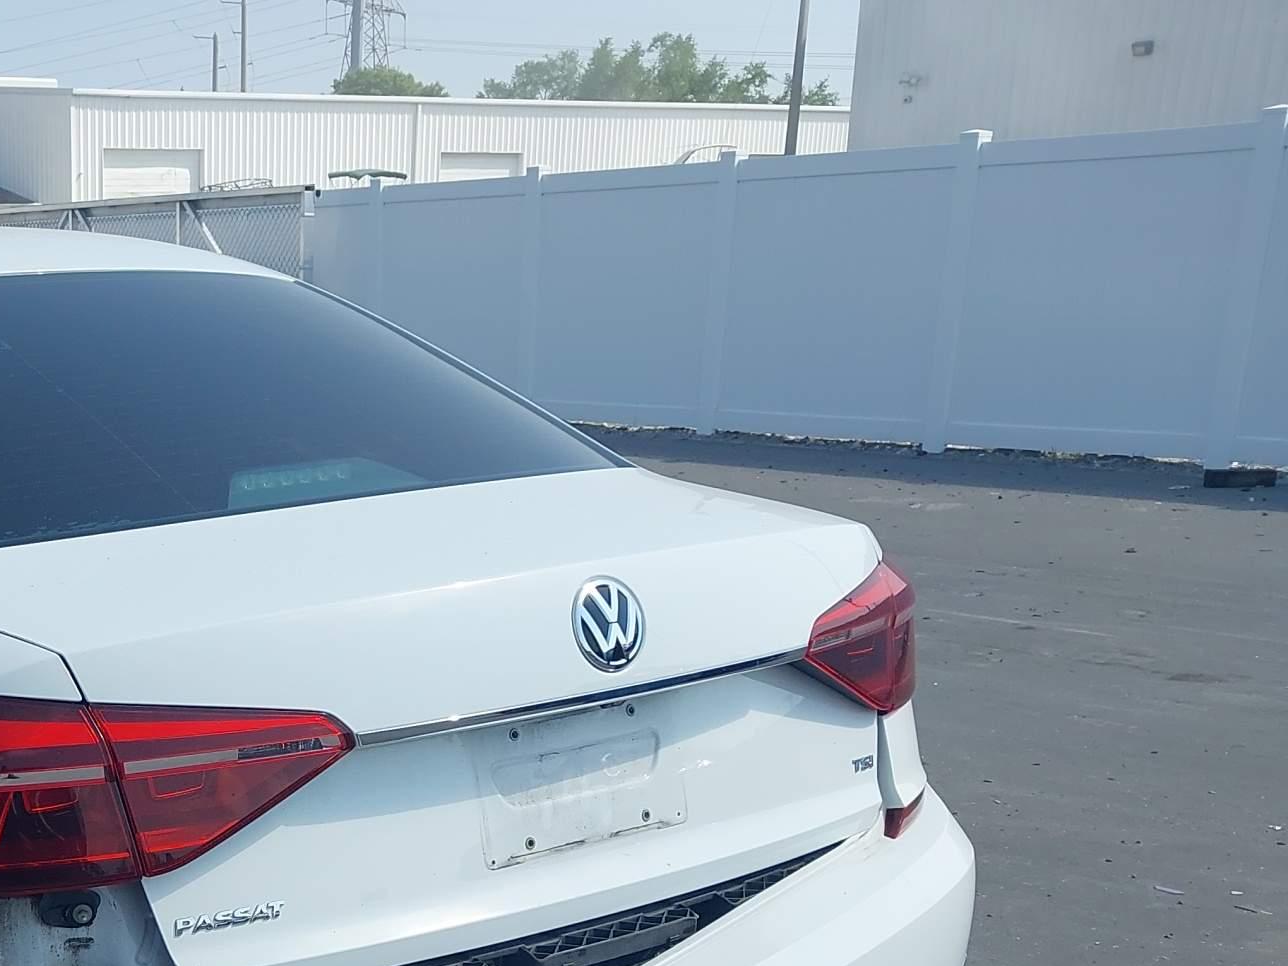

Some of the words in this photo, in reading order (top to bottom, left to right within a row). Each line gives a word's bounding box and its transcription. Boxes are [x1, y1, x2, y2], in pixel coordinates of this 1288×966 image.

[571, 575, 646, 673] VW
[851, 754, 874, 773] TSI
[173, 899, 284, 937] PASSAT
